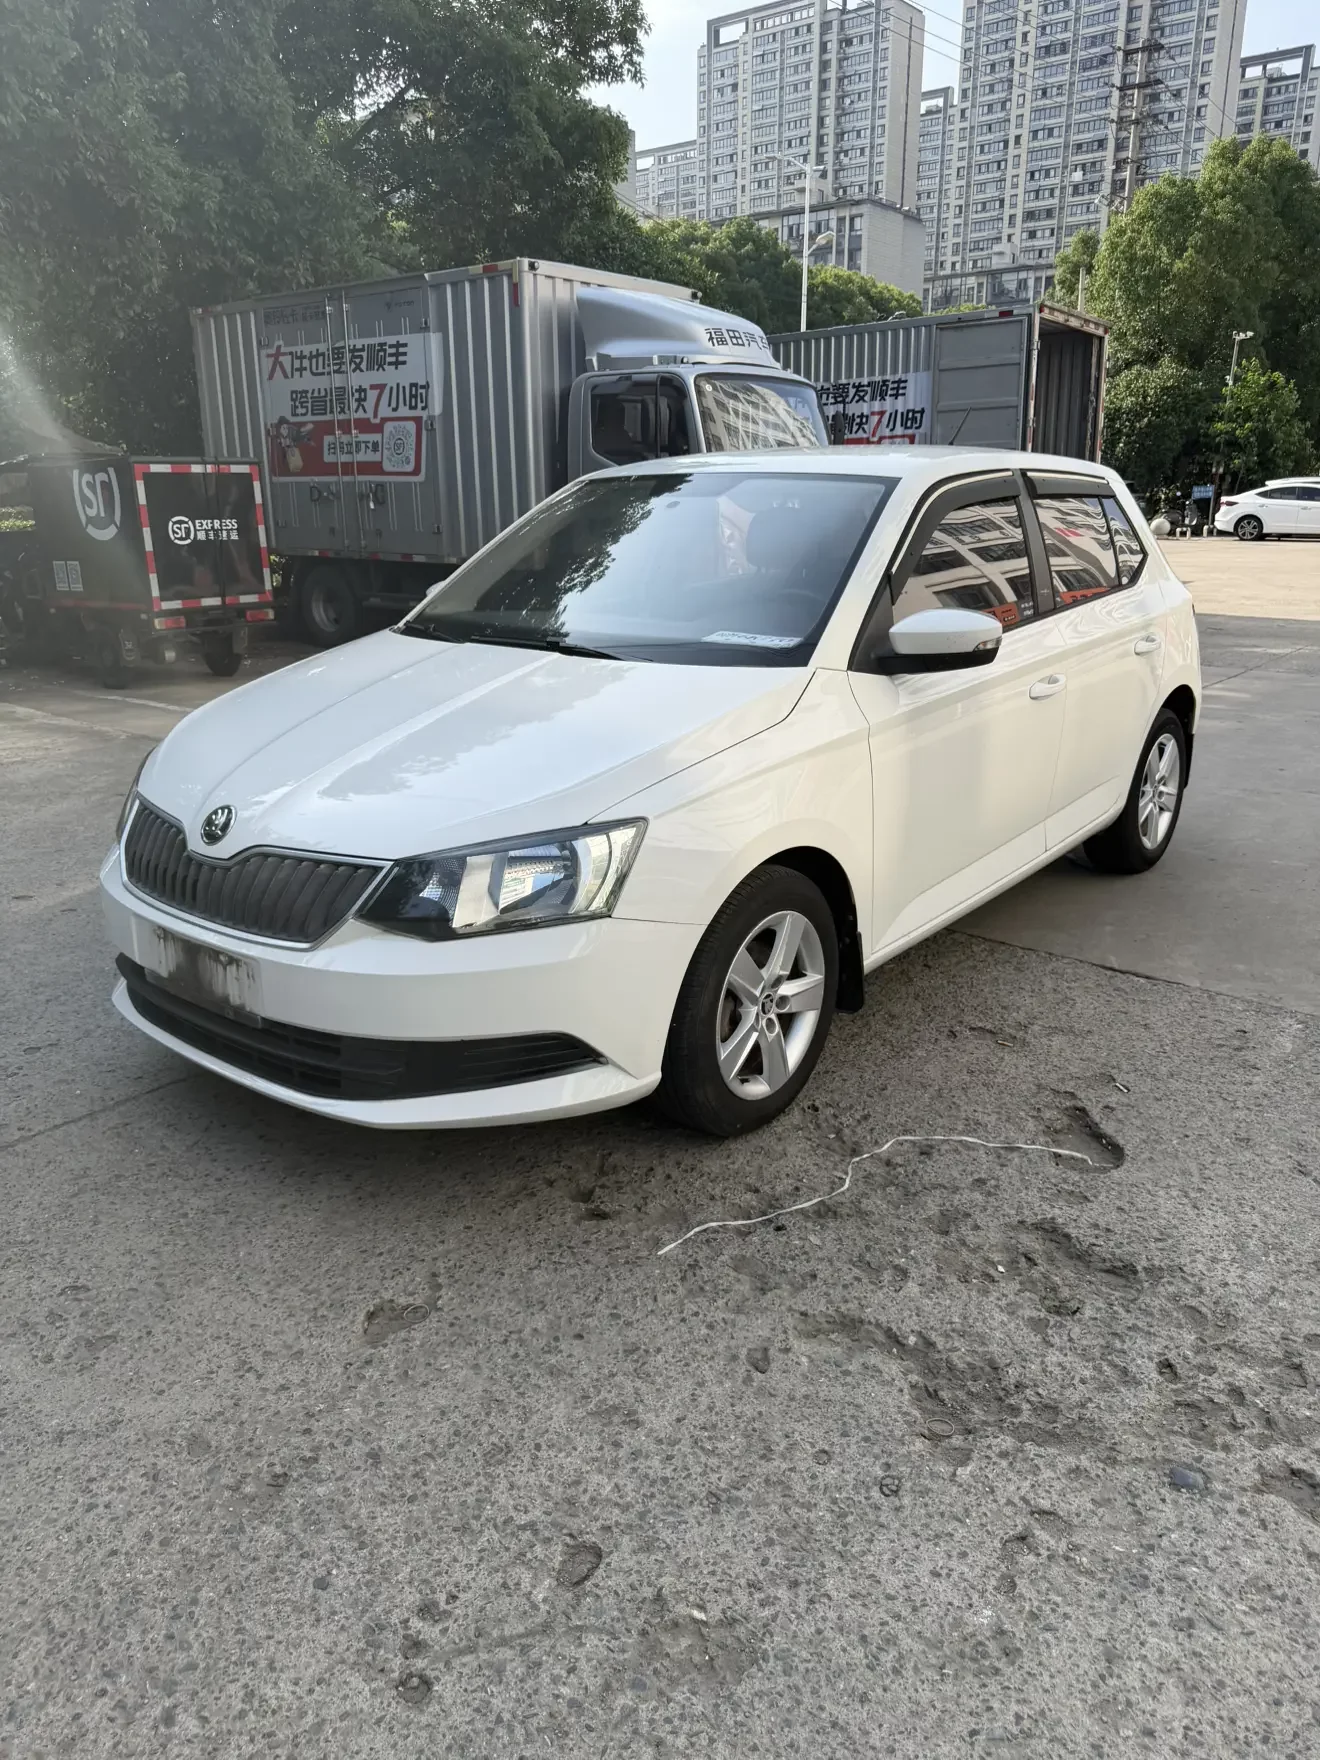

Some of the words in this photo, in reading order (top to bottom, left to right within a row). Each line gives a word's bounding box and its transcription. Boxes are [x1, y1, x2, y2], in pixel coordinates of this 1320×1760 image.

[266, 340, 408, 380] 大件也要发顺丰
[290, 381, 430, 419] 跨省最快7小时
[195, 519, 238, 530] EXPRESS
